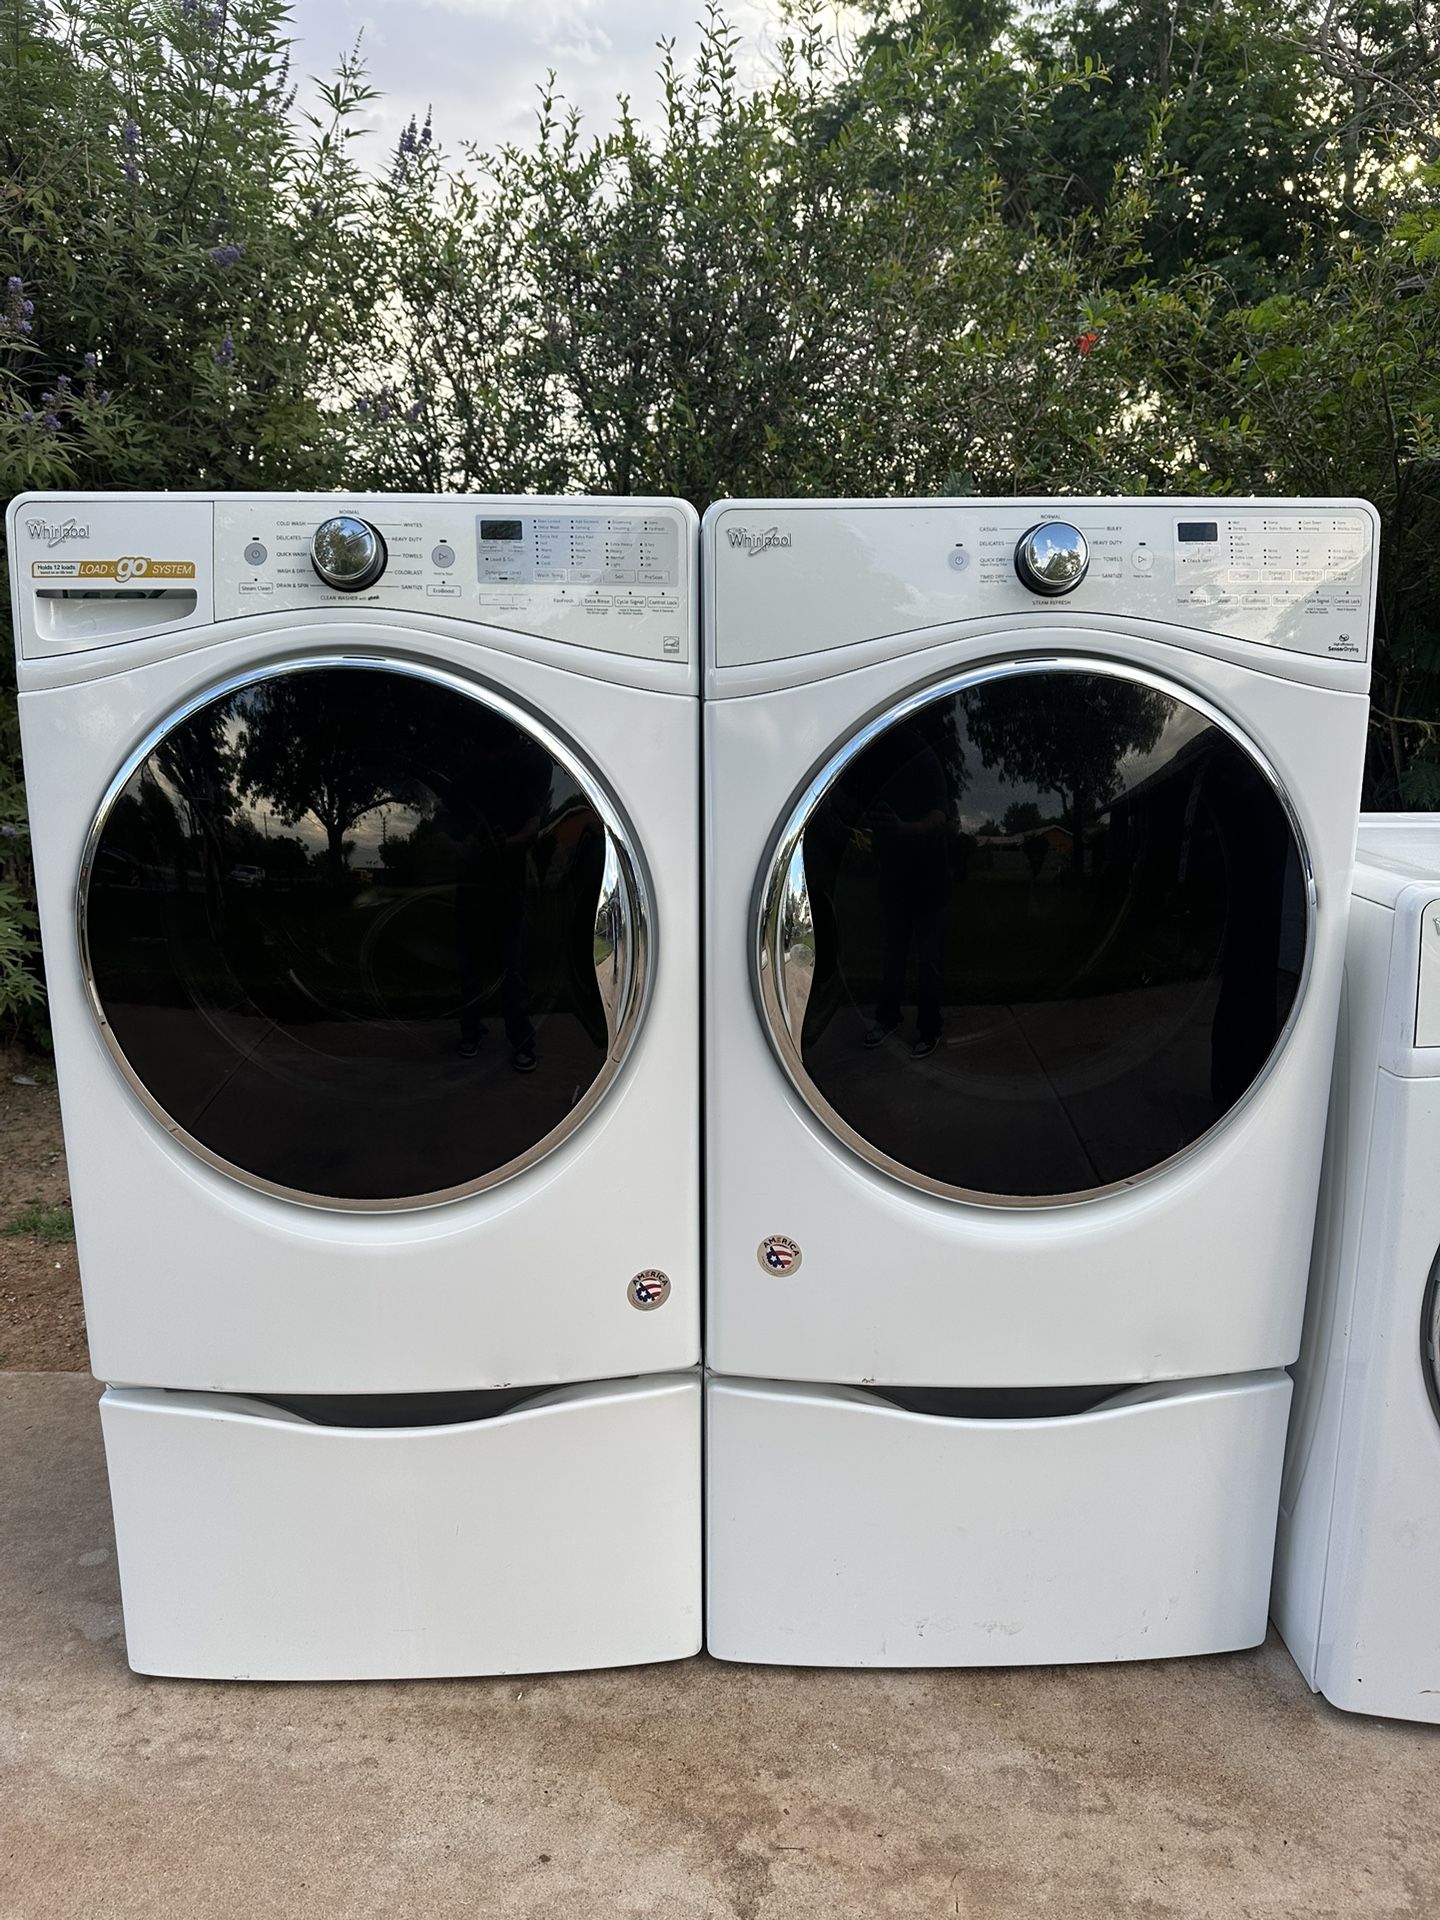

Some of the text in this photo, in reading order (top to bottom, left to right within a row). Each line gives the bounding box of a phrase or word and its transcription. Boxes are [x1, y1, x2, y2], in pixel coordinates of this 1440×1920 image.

[26, 519, 90, 547] Whirlpool
[727, 527, 792, 556] Whirlpool
[80, 565, 108, 574] LOAD
[115, 557, 148, 582] go
[152, 565, 192, 574] SYSTEM
[764, 1237, 799, 1256] AMERICA
[633, 1271, 668, 1286] AMERICA
